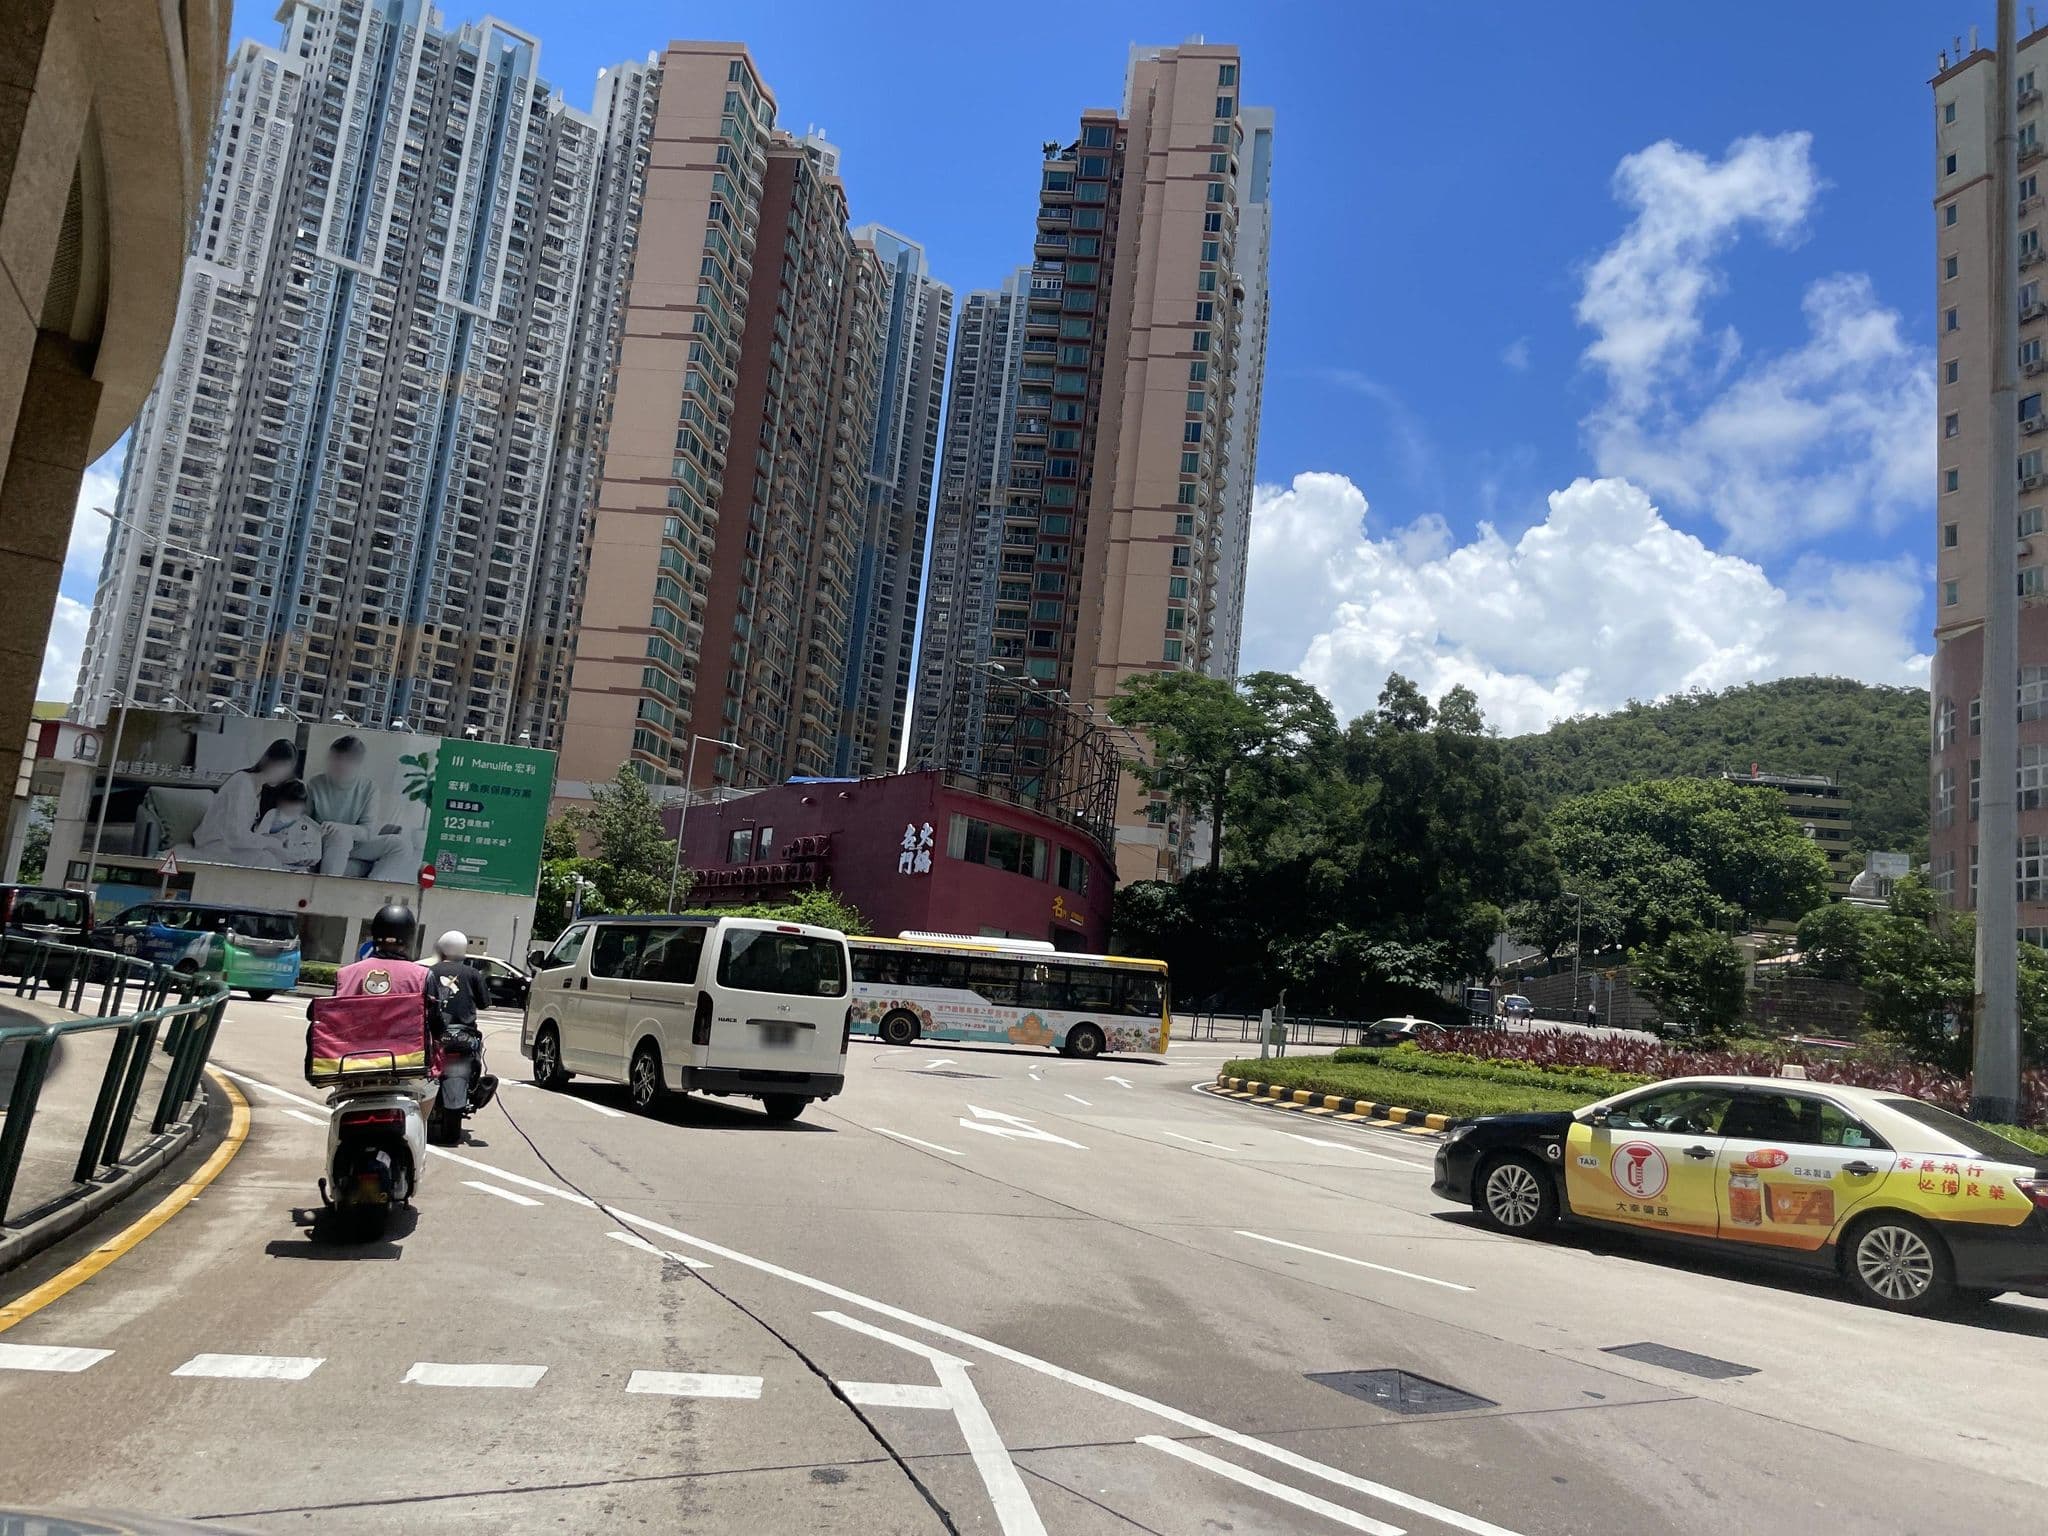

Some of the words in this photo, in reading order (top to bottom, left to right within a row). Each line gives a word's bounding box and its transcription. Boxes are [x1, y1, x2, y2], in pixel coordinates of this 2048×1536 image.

[471, 758, 513, 773] Manulife
[514, 762, 537, 775] 宏利
[1548, 1146, 1558, 1158] 4
[1579, 1157, 1597, 1166] TAXI
[1898, 1157, 1984, 1178] 家居旅行
[1793, 1166, 1832, 1179] 日本製造
